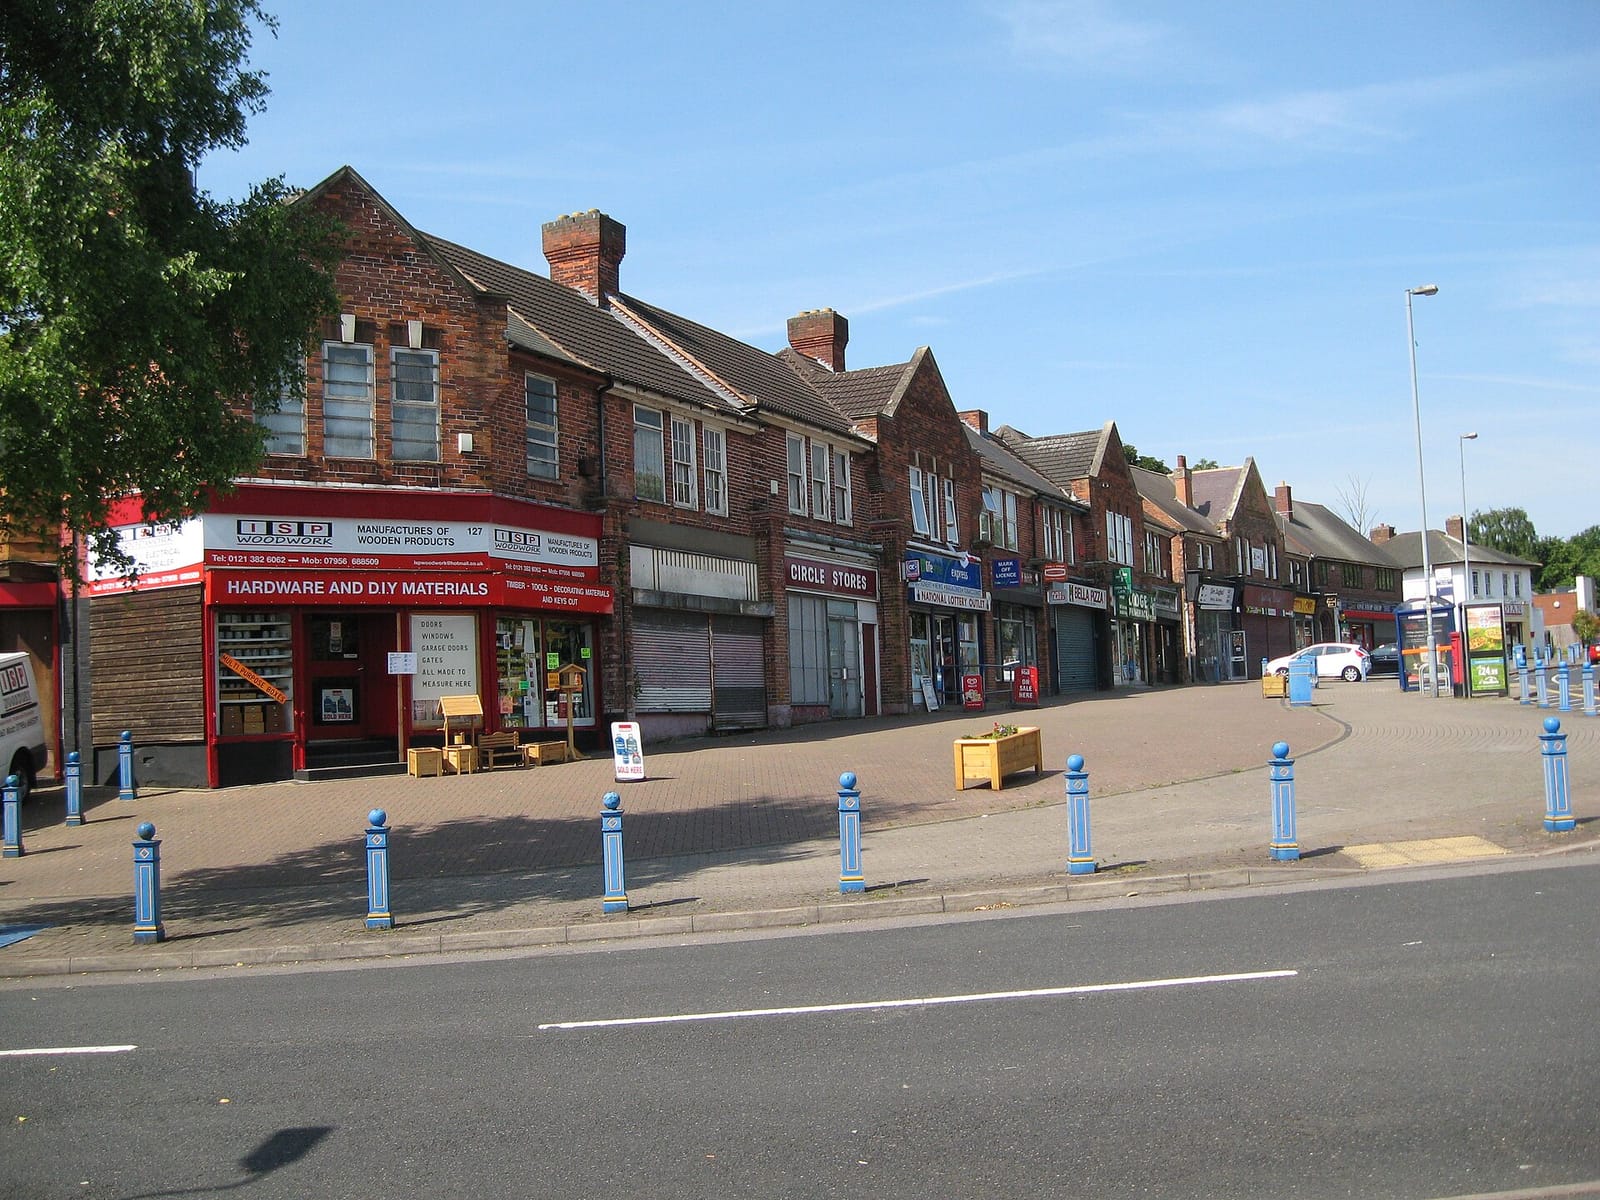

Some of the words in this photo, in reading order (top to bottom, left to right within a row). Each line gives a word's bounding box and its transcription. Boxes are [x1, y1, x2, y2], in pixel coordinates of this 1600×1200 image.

[249, 522, 325, 535] ISP
[357, 525, 433, 535] MANUFACTURES
[436, 527, 450, 536] OF
[467, 527, 483, 536] 127
[237, 535, 333, 546] WOODWORK
[357, 535, 401, 545] WOODEN
[404, 537, 455, 547] PRODUCTS
[547, 537, 583, 549] MANUFACTURES
[494, 542, 541, 553] WOODWORK
[548, 546, 569, 555] WOODEN
[569, 549, 593, 558] PRODUCTS
[211, 554, 227, 562] Tel:
[228, 554, 248, 562] 0121
[249, 555, 266, 563] 382
[301, 556, 323, 565] Mob:
[323, 557, 348, 565] 07956
[351, 558, 380, 566] 688509
[790, 563, 825, 585] CIRCLE
[832, 570, 867, 591] STORES
[227, 580, 325, 594] HARDWARE
[328, 581, 364, 595] AND
[402, 582, 489, 596] MATERIALS
[506, 580, 526, 590] TIMBER
[531, 583, 549, 592] TOOLS
[553, 585, 585, 596] DECORATING
[584, 588, 610, 598] MATERIALS
[1074, 586, 1090, 601] BELLA
[542, 595, 554, 604] AND
[553, 596, 567, 605] KEYS
[921, 591, 947, 605] NATIONAL
[947, 595, 968, 607] LOTTERY
[968, 598, 986, 609] OUTLET
[1128, 592, 1149, 609] LODGE
[422, 632, 455, 640] WINDOWS
[421, 644, 446, 652] GARAGE
[447, 644, 469, 652] DOORS
[422, 656, 444, 664] GATES
[422, 668, 436, 676] ALL
[437, 668, 456, 676] MADE
[458, 668, 467, 676] TO
[239, 668, 266, 689] PURPOSE
[265, 686, 287, 703] BOXES
[422, 680, 453, 688] MEASURE
[455, 680, 472, 688] HERE
